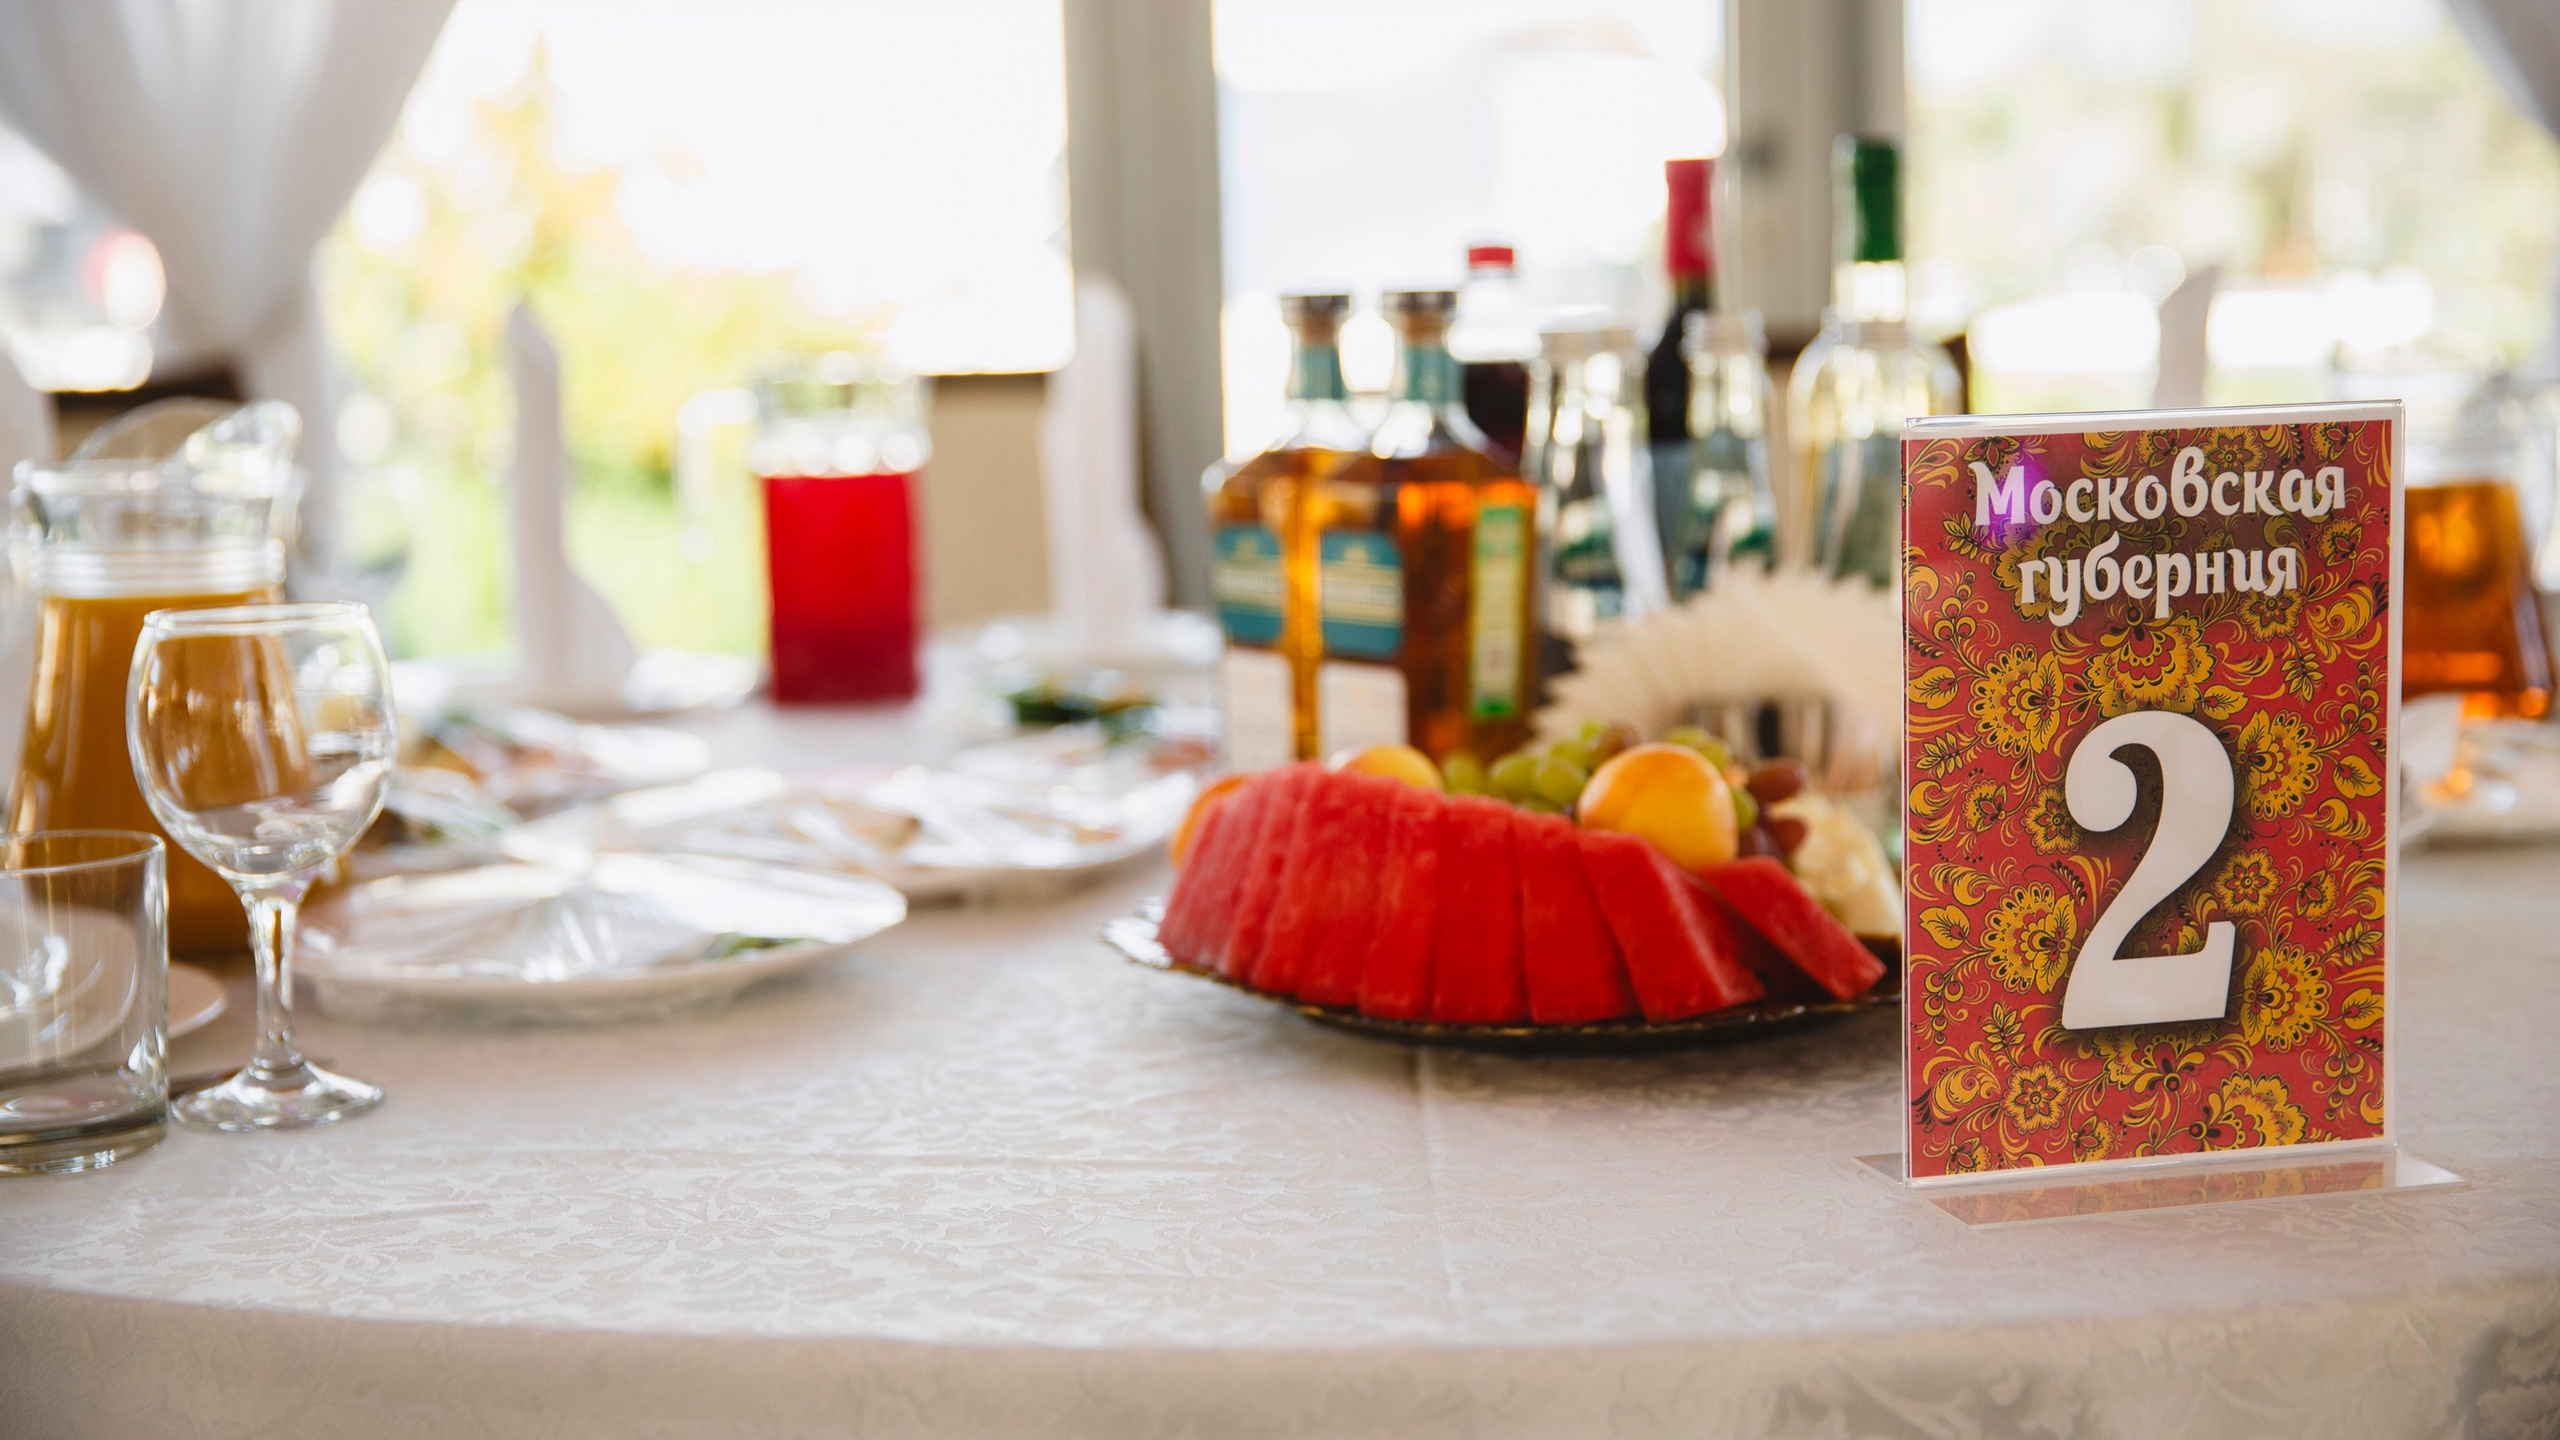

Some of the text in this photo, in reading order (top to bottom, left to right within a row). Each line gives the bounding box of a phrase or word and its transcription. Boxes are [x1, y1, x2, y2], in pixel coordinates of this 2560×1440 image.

[1968, 446, 2346, 527] Московская
[2018, 531, 2298, 627] губерния
[2062, 711, 2236, 1030] 2
